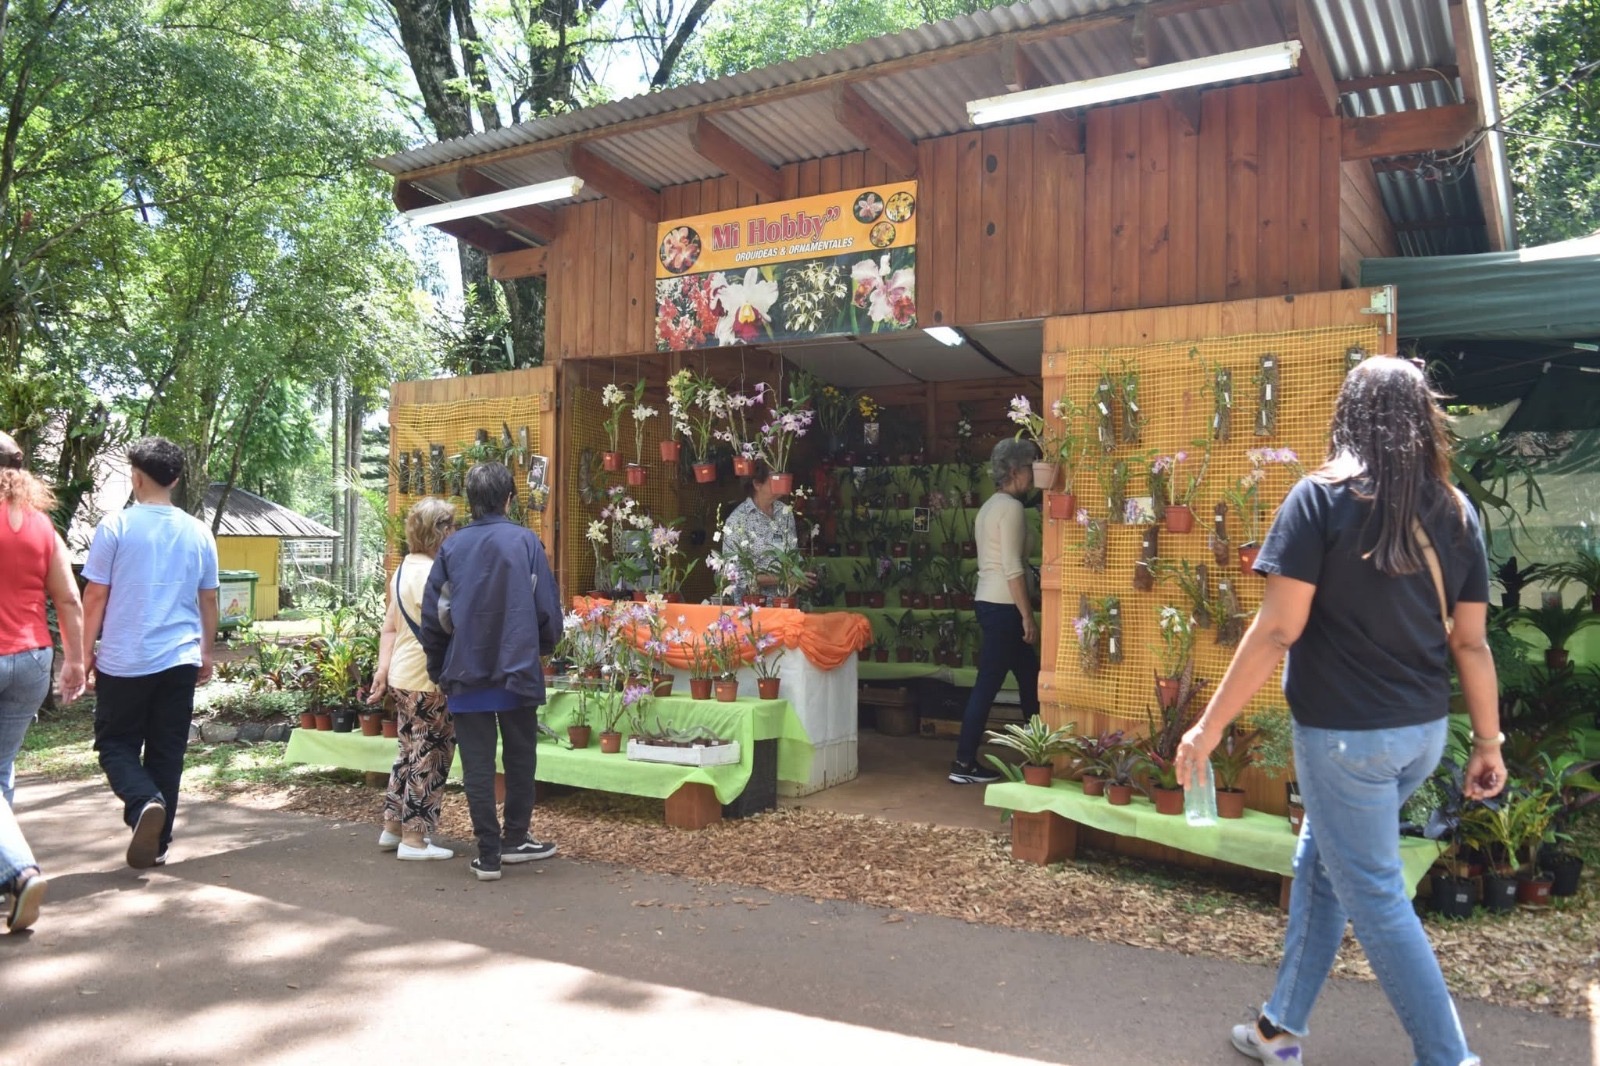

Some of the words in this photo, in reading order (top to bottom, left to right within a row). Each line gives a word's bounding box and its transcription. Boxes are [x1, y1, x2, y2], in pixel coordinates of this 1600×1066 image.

[713, 222, 740, 251] Mi
[780, 246, 787, 256] &
[788, 237, 854, 255] ORNAMENTALES
